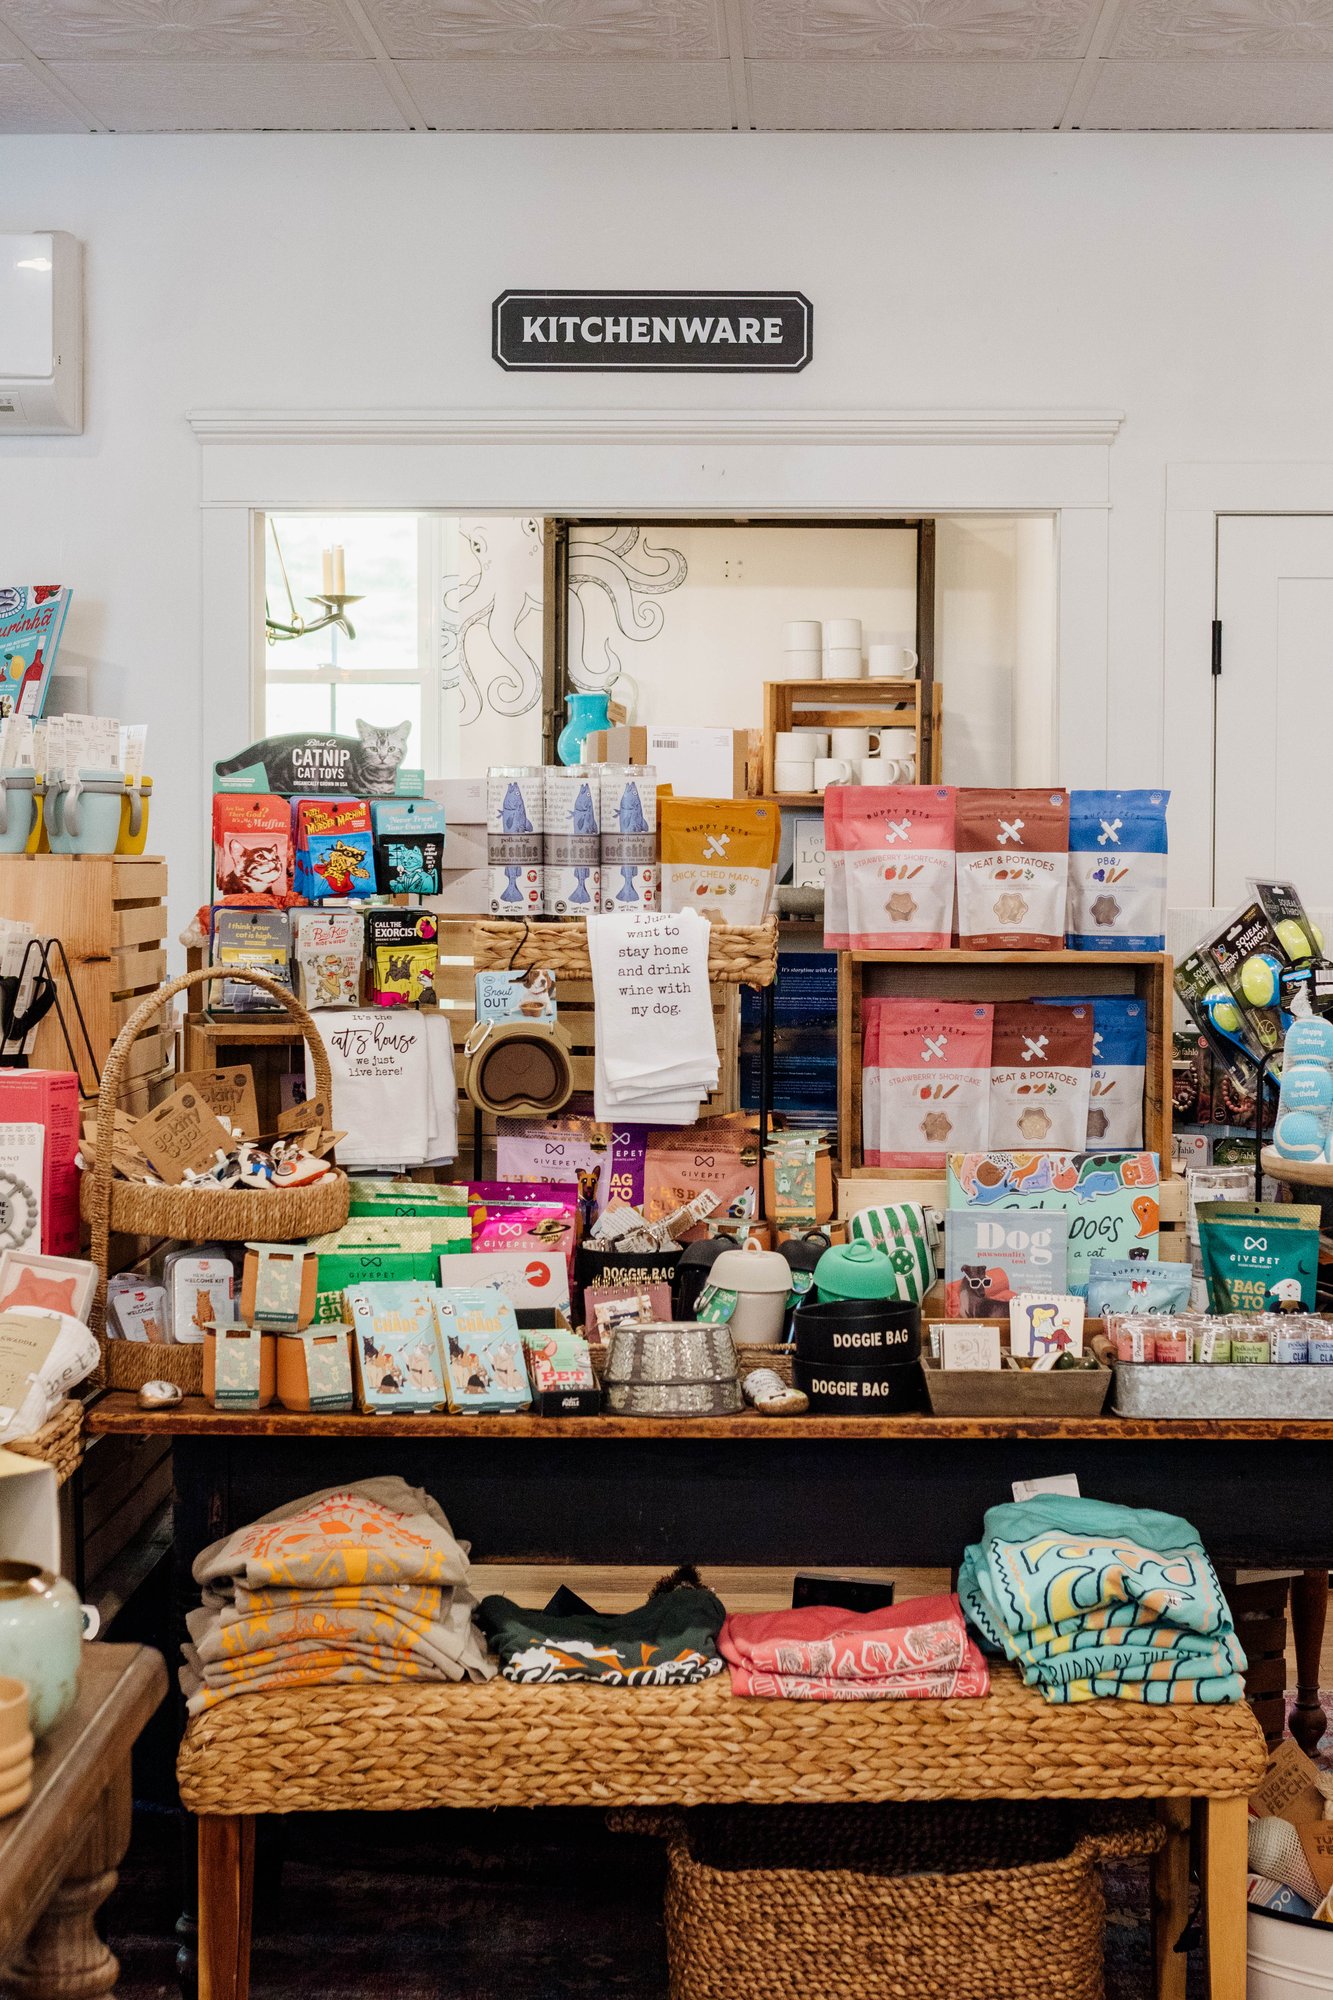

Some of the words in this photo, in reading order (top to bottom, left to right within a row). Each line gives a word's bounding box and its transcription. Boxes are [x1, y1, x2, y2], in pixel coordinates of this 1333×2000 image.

[522, 316, 784, 344] KITCHENWARE
[292, 748, 350, 766] CATNIP
[298, 768, 316, 779] CAT
[319, 768, 344, 780] TOYS
[867, 809, 898, 819] BUPPY
[906, 809, 930, 819] PETS
[247, 819, 288, 829] Muffin.
[305, 819, 335, 834] MURDER
[335, 808, 367, 826] MACHINE
[686, 824, 718, 833] BUPPY
[724, 826, 749, 836] PETS
[490, 844, 506, 857] cod
[509, 844, 538, 857] skins
[605, 843, 624, 857] cod
[854, 855, 901, 868] STRAWBERRY
[904, 855, 948, 868] SHORTCAKE
[969, 857, 993, 871] MEAT
[997, 856, 1003, 864] &
[1006, 856, 1055, 871] POTATOES
[1097, 857, 1121, 866] PB&J
[672, 870, 697, 883] CHICK
[700, 869, 725, 879] CHED
[729, 871, 760, 887] MARYS
[634, 915, 641, 923] I
[375, 928, 418, 938] EXORCIST
[627, 928, 659, 938] want
[665, 926, 679, 936] to
[1235, 921, 1262, 949] SQUEAK
[1240, 948, 1247, 956] &
[1245, 926, 1269, 951] THROW
[619, 947, 649, 959] stay
[654, 945, 688, 955] home
[1219, 951, 1239, 972] Spunky
[618, 965, 643, 976] and
[648, 963, 690, 975] drink
[1193, 964, 1208, 980] SQUE
[484, 986, 512, 997] Snout
[619, 985, 653, 995] wine
[658, 982, 691, 994] with
[484, 998, 508, 1008] OUT
[632, 1006, 648, 1017] my
[653, 1003, 681, 1016] dog.
[903, 1025, 935, 1036] BUPPY
[942, 1026, 966, 1036] PETS
[331, 1028, 373, 1057] cat's
[374, 1022, 417, 1053] house
[1182, 1048, 1199, 1056] fahlo
[372, 1056, 395, 1066] just
[349, 1068, 372, 1076] live
[375, 1067, 403, 1076] here!
[888, 1073, 936, 1086] STRAWBERRY
[939, 1073, 982, 1086] SHORTCAKE
[991, 1073, 1016, 1086] MEAT
[1030, 1071, 1078, 1086] POTATOES
[213, 1101, 236, 1116] go!
[155, 1133, 172, 1152] go
[168, 1108, 200, 1136] kitty
[180, 1123, 200, 1150] go!
[1179, 1145, 1195, 1154] fahlo
[534, 1158, 577, 1166] GIVEPET
[610, 1174, 633, 1186] AG
[681, 1171, 726, 1179] GIVEPET
[610, 1188, 633, 1200] TO
[1068, 1216, 1123, 1243] DOGS
[975, 1222, 1053, 1265] Dog
[1087, 1247, 1106, 1258] cat
[1230, 1254, 1280, 1265] GIVEPET
[603, 1266, 648, 1280] DOGGIE
[652, 1267, 675, 1280] BAG
[1113, 1268, 1140, 1277] BUPPY
[1146, 1269, 1167, 1280] PETS
[1233, 1280, 1266, 1295] BAG
[1242, 1295, 1264, 1309] TO
[127, 1307, 153, 1316] WELCOME
[373, 1317, 419, 1332] CHAOS
[456, 1317, 502, 1332] CHAOS
[833, 1332, 882, 1349] DOGGIE
[885, 1328, 908, 1346] BAG
[541, 1371, 584, 1382] PET
[812, 1379, 858, 1397] DOGGIE
[862, 1379, 889, 1396] BAG
[1168, 1595, 1177, 1606] XL
[1049, 1655, 1104, 1686] BUDDY
[1260, 1782, 1280, 1802] TUG
[1266, 1770, 1312, 1815] FETCH!
